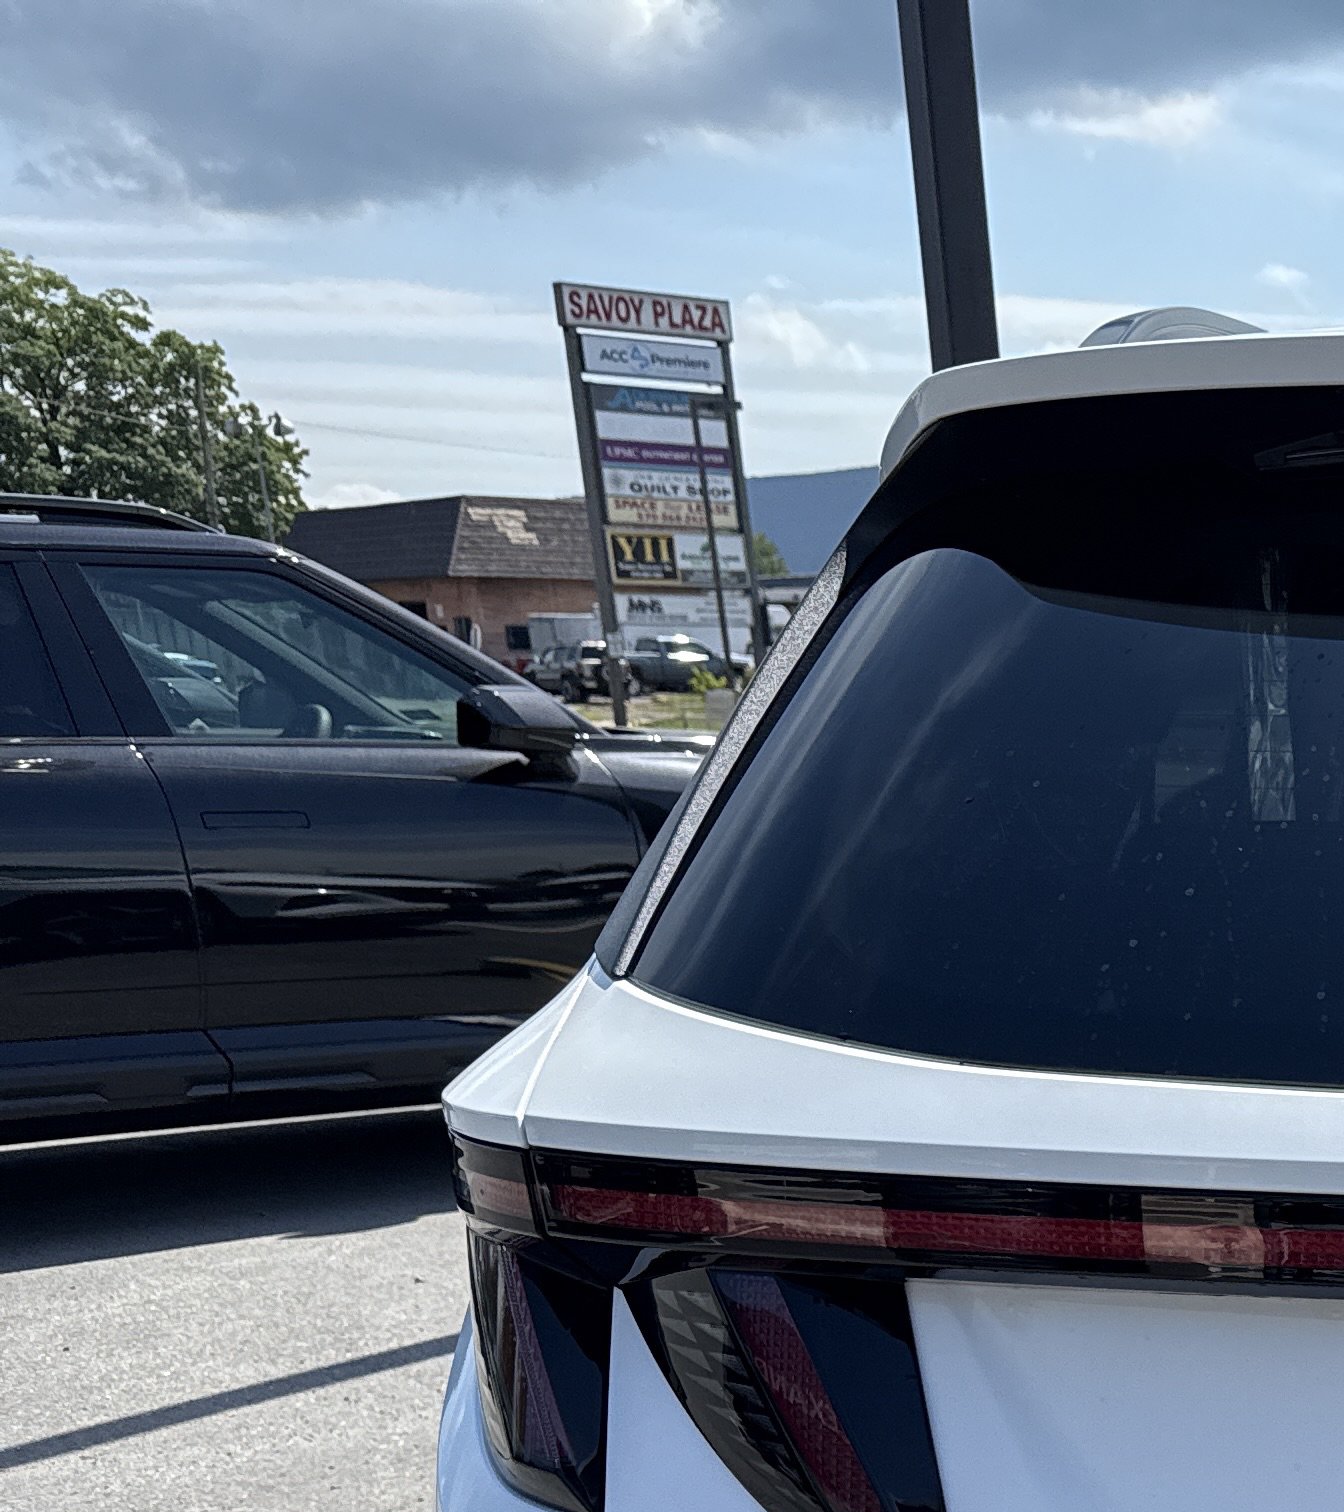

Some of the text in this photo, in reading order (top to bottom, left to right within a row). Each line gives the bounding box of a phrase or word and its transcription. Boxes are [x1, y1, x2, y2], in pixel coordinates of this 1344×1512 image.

[569, 290, 726, 334] SAVOY PLAZA
[600, 348, 628, 364] ACC
[629, 481, 680, 496] QUILT
[687, 502, 729, 515] LESE
